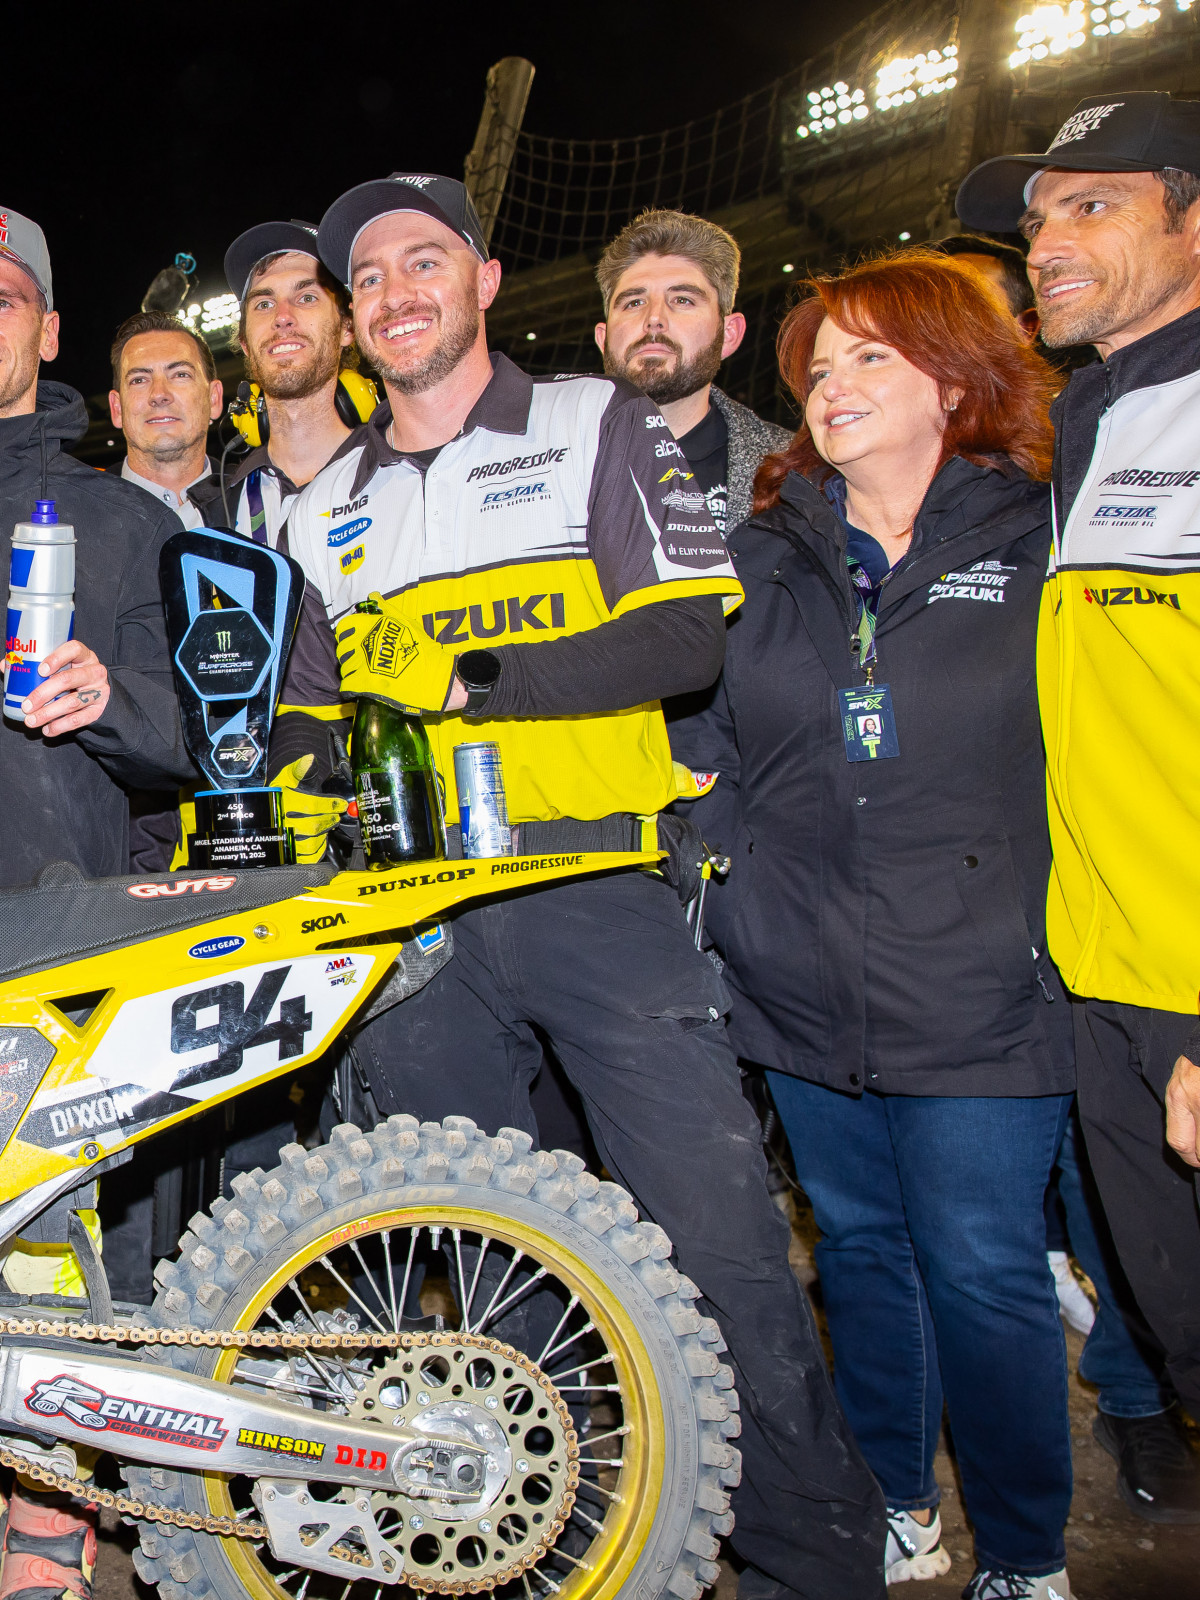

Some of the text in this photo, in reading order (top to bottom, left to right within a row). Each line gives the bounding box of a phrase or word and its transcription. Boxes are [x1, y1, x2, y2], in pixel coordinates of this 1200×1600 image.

[466, 447, 569, 482] PROGRESSIVE
[482, 482, 547, 505] ECSTAR
[331, 495, 369, 518] PMG
[1093, 505, 1157, 519] ECSTAR
[348, 520, 368, 535] GEAR
[667, 523, 716, 532] DUNLOP
[341, 546, 364, 568] WD-40
[14, 637, 37, 653] Bull
[376, 621, 401, 670] DIXXON
[848, 696, 883, 711] SMX
[219, 749, 249, 761] SMX
[227, 803, 244, 811] 450
[217, 811, 254, 821] 2nd Place
[362, 813, 381, 824] 450
[366, 822, 401, 834] Place
[212, 836, 243, 845] STADIUM
[255, 834, 287, 842] ANAHEIM
[211, 853, 238, 861] January
[214, 845, 250, 853] ANAHEIM,
[490, 855, 584, 876] PROGRESSIVE
[127, 875, 237, 898] GUTS
[357, 868, 477, 896] DUNLOP
[191, 938, 242, 956] CYCLE GEAR
[325, 957, 353, 973] AMA
[330, 971, 358, 987] SMX
[170, 965, 313, 1093] 94
[49, 1094, 134, 1138] DIXXON
[25, 1375, 228, 1441] RENTHAL
[109, 1420, 220, 1451] CHAINWHEELS
[238, 1429, 325, 1456] HINSON
